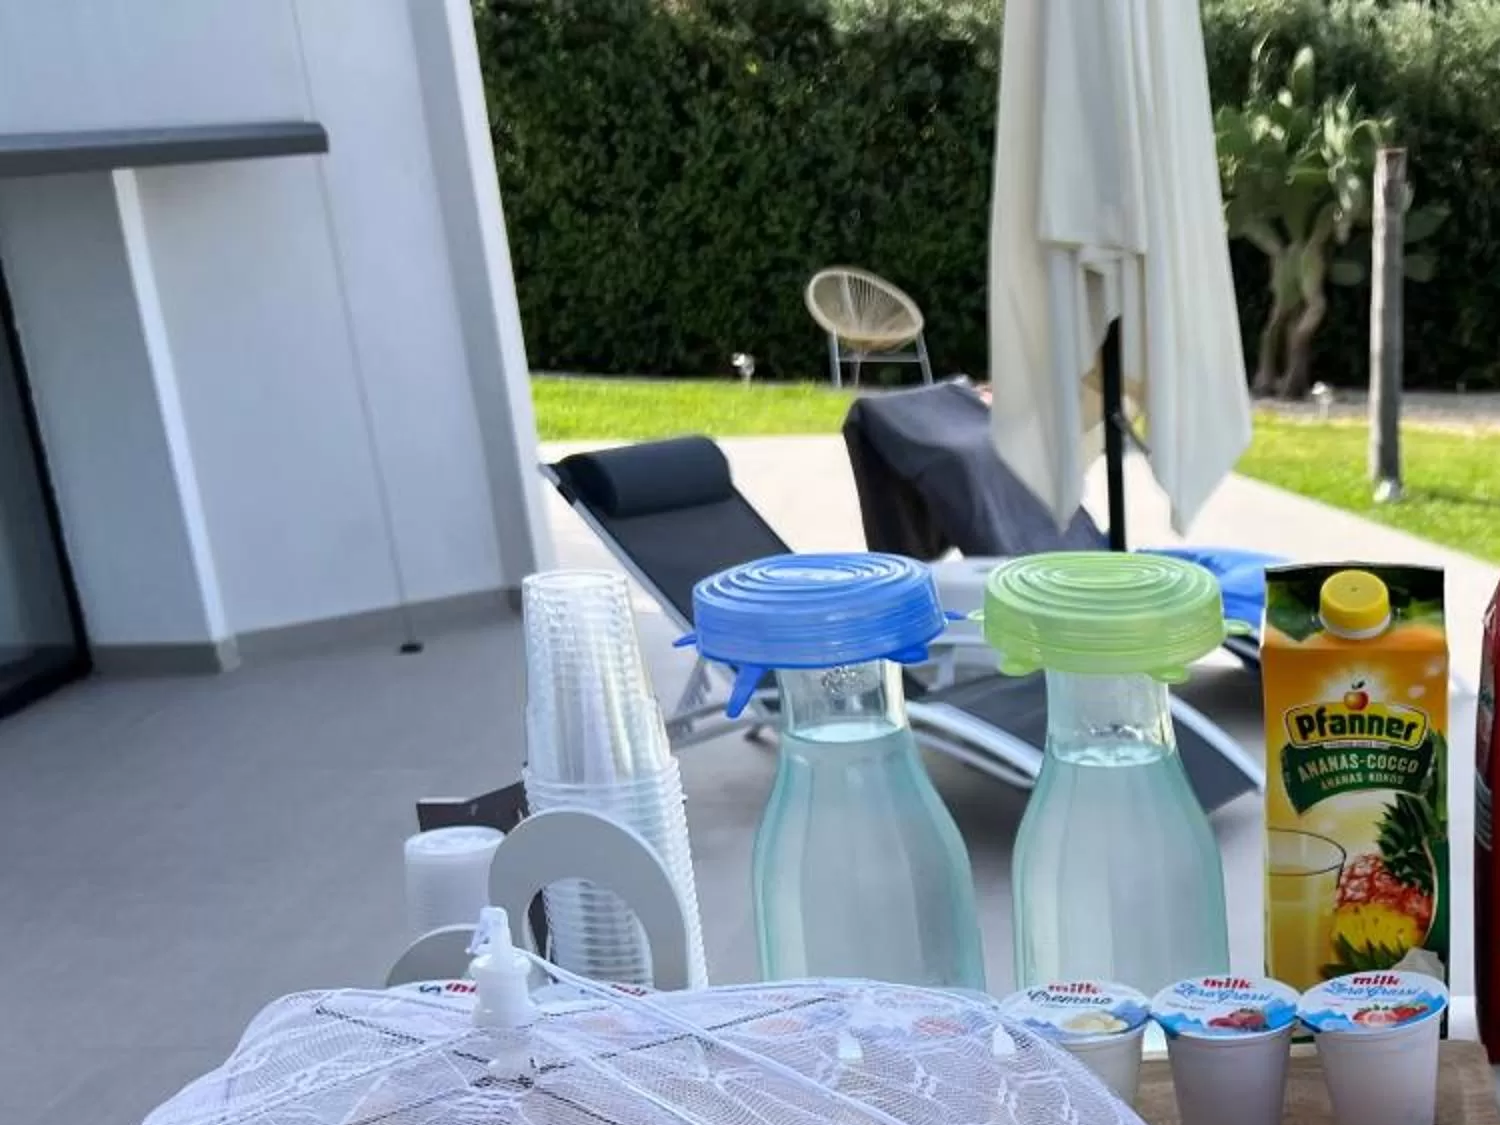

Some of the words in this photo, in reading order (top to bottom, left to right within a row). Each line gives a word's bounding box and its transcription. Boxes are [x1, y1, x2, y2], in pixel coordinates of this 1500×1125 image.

[1298, 752, 1419, 783] ANANAS-COCCO
[1203, 978, 1252, 989] milk
[1353, 975, 1400, 985] milk
[1048, 982, 1100, 994] milk
